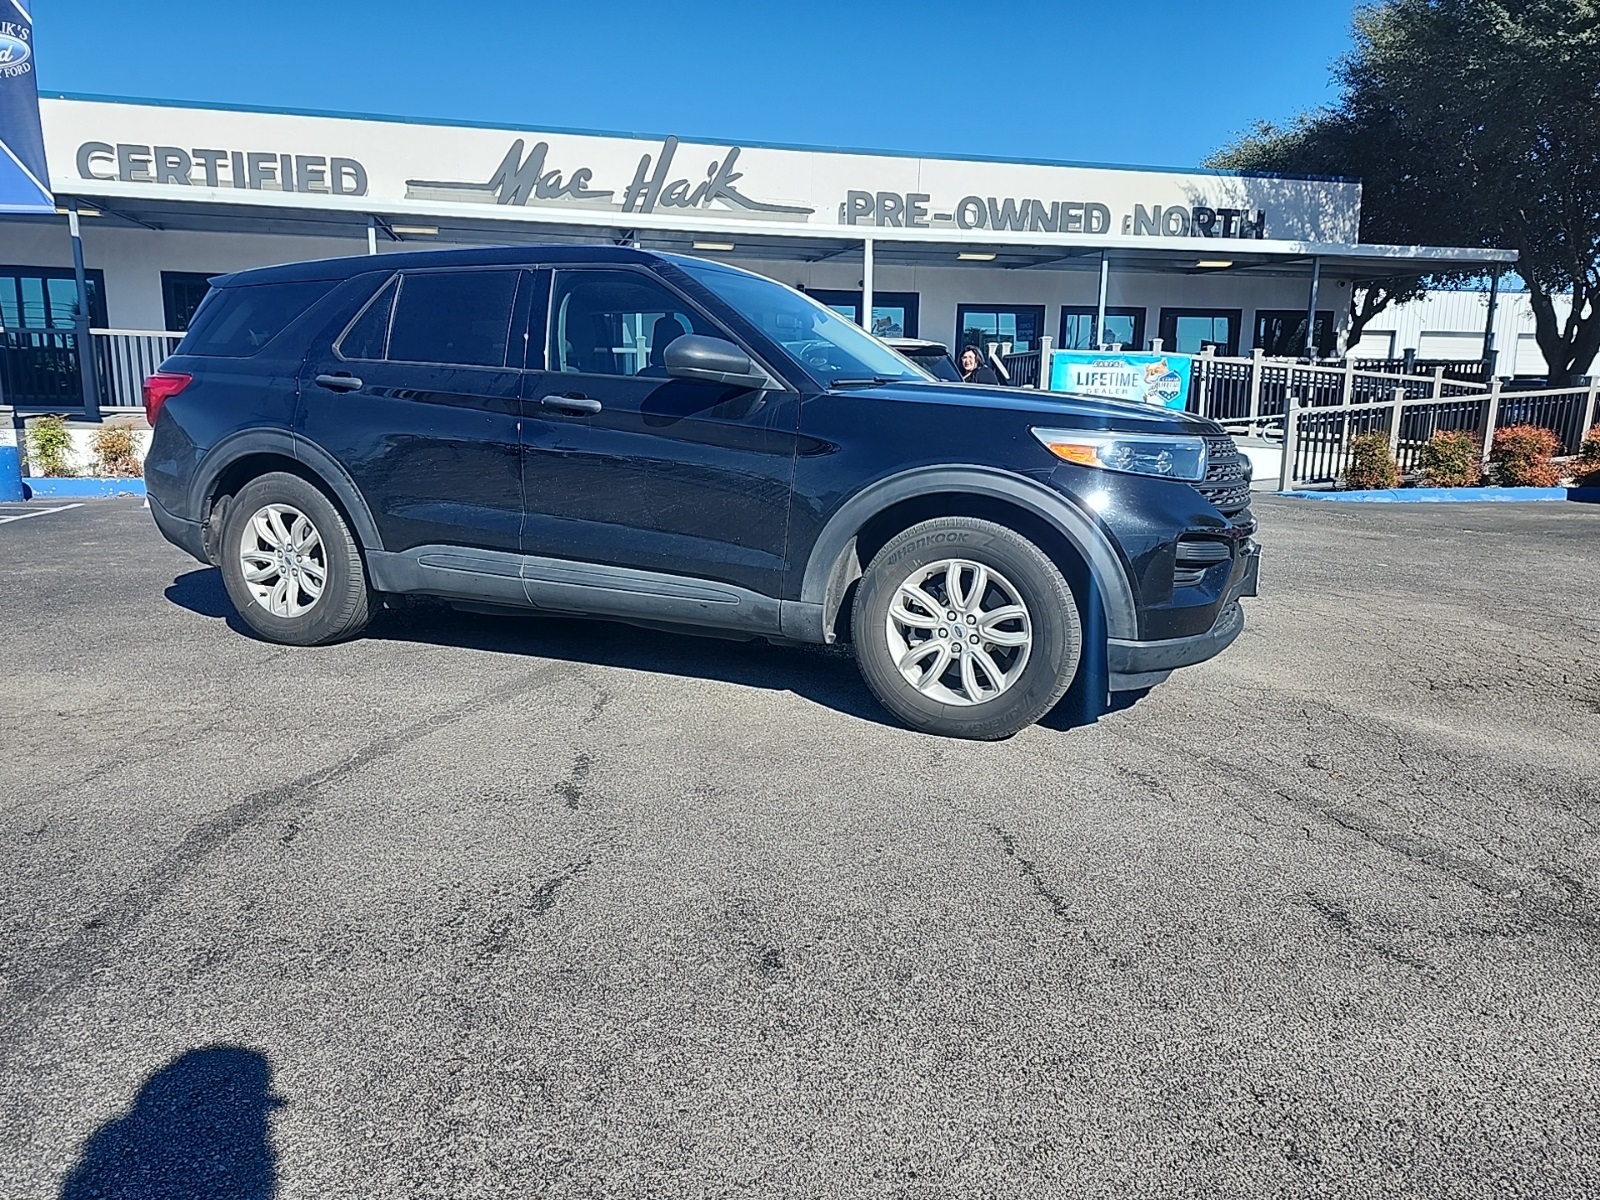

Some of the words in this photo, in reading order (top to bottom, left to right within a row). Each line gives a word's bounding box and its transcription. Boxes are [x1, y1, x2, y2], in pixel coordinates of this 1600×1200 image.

[0, 21, 30, 40] IK'S
[4, 62, 31, 78] FORD
[76, 141, 368, 197] CERTIFIED
[405, 138, 614, 206] Mac
[622, 135, 815, 214] Haik
[846, 190, 1111, 235] PRE-OWNED
[1134, 204, 1267, 239] NORTH
[1076, 372, 1139, 388] LIFETIME
